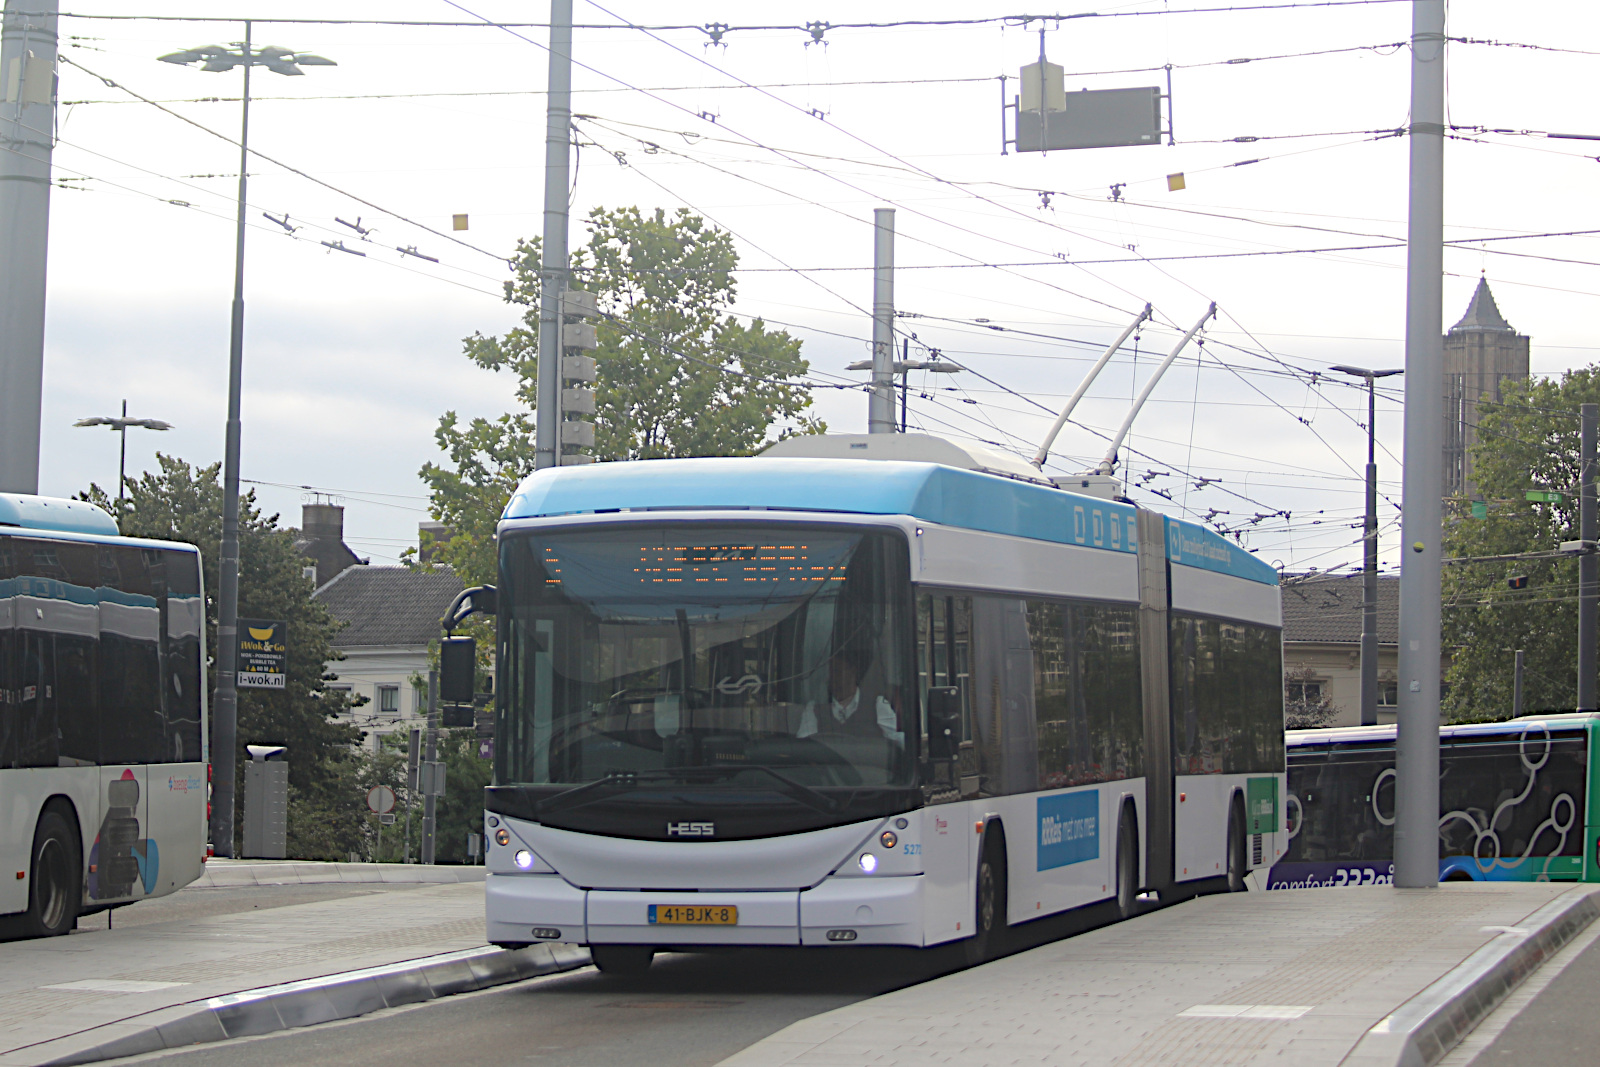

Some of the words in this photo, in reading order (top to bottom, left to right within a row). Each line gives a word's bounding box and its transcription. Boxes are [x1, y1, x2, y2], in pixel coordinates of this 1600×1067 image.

[1547, 493, 1559, 501] E3
[240, 672, 284, 686] i-wok.nl
[667, 822, 714, 835] HESS
[664, 908, 729, 922] 41-BJK-8
